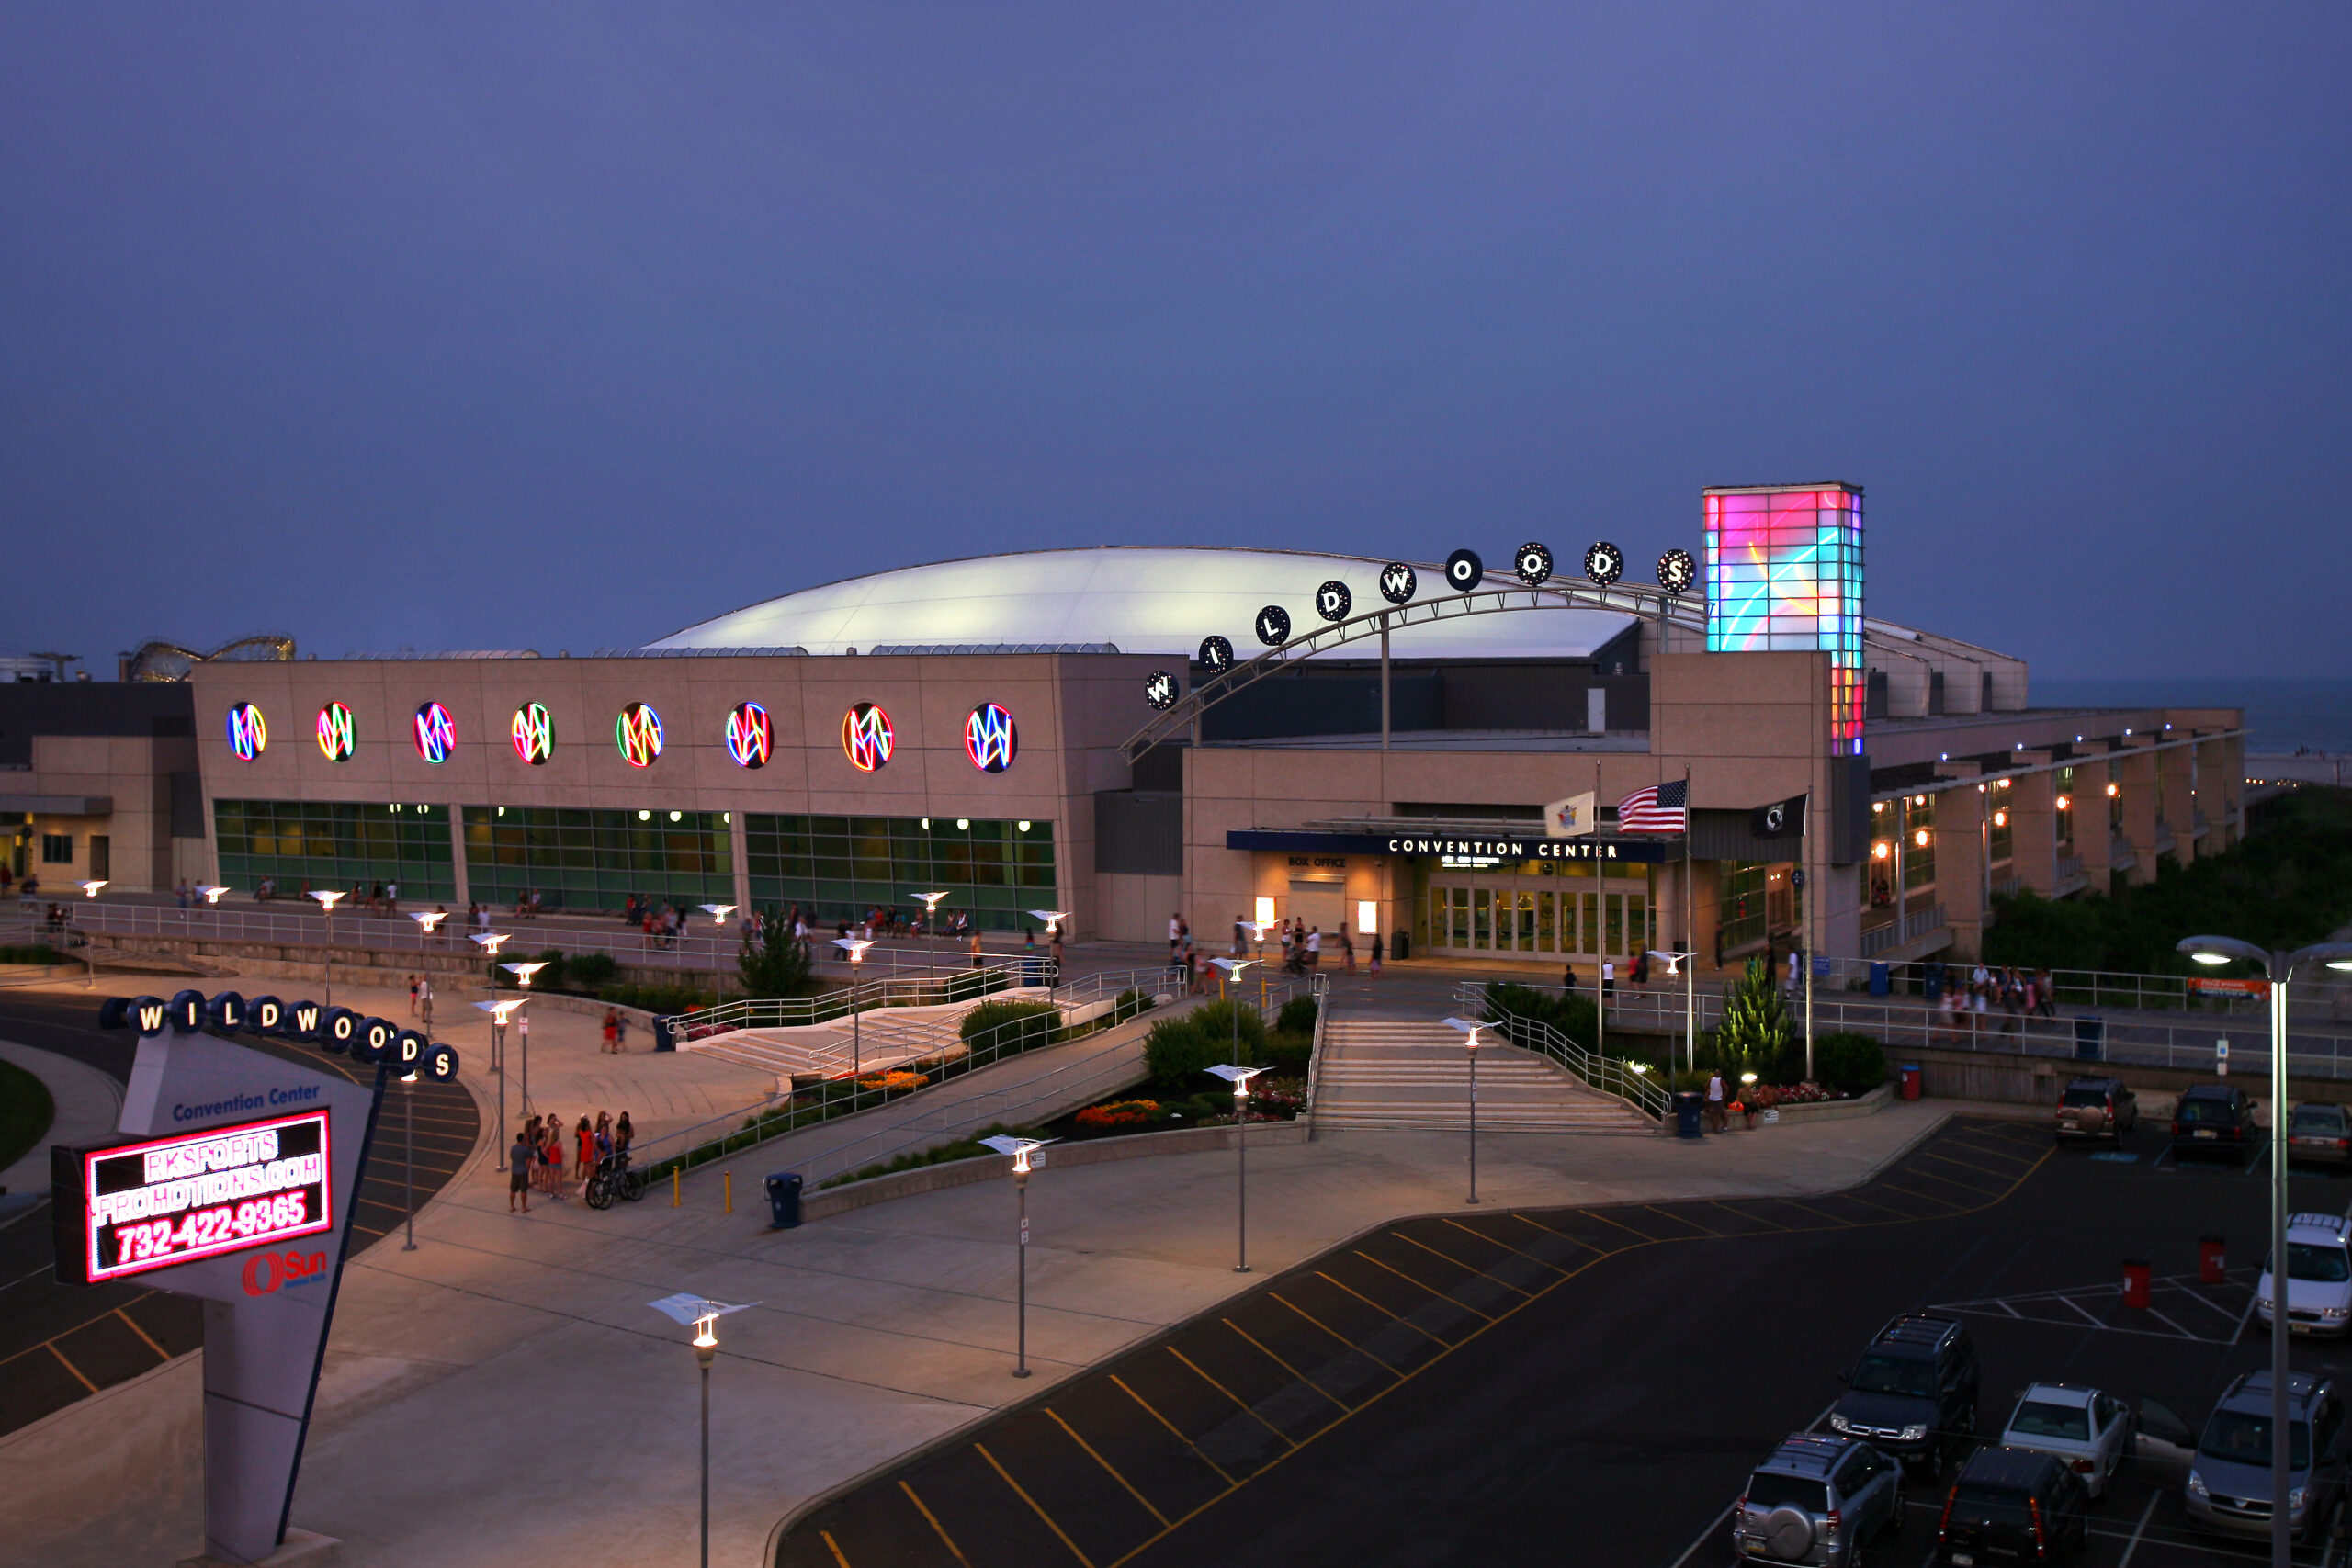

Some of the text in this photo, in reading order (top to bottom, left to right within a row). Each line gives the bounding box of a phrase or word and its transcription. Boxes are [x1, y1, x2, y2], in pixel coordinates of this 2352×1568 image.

[1147, 553, 1683, 702] WILDWOODS
[1288, 856, 1346, 868] BOX OFFICE
[1388, 839, 1617, 859] CONVENTION CENTER
[139, 1001, 450, 1077] WILDWOODS
[173, 1085, 320, 1122] Convention Center
[145, 1130, 278, 1182] RKSPORTS
[96, 1155, 321, 1224] PROMOTIONS.COM
[115, 1190, 306, 1264] 732-422-9365
[284, 1250, 326, 1280] Sun
